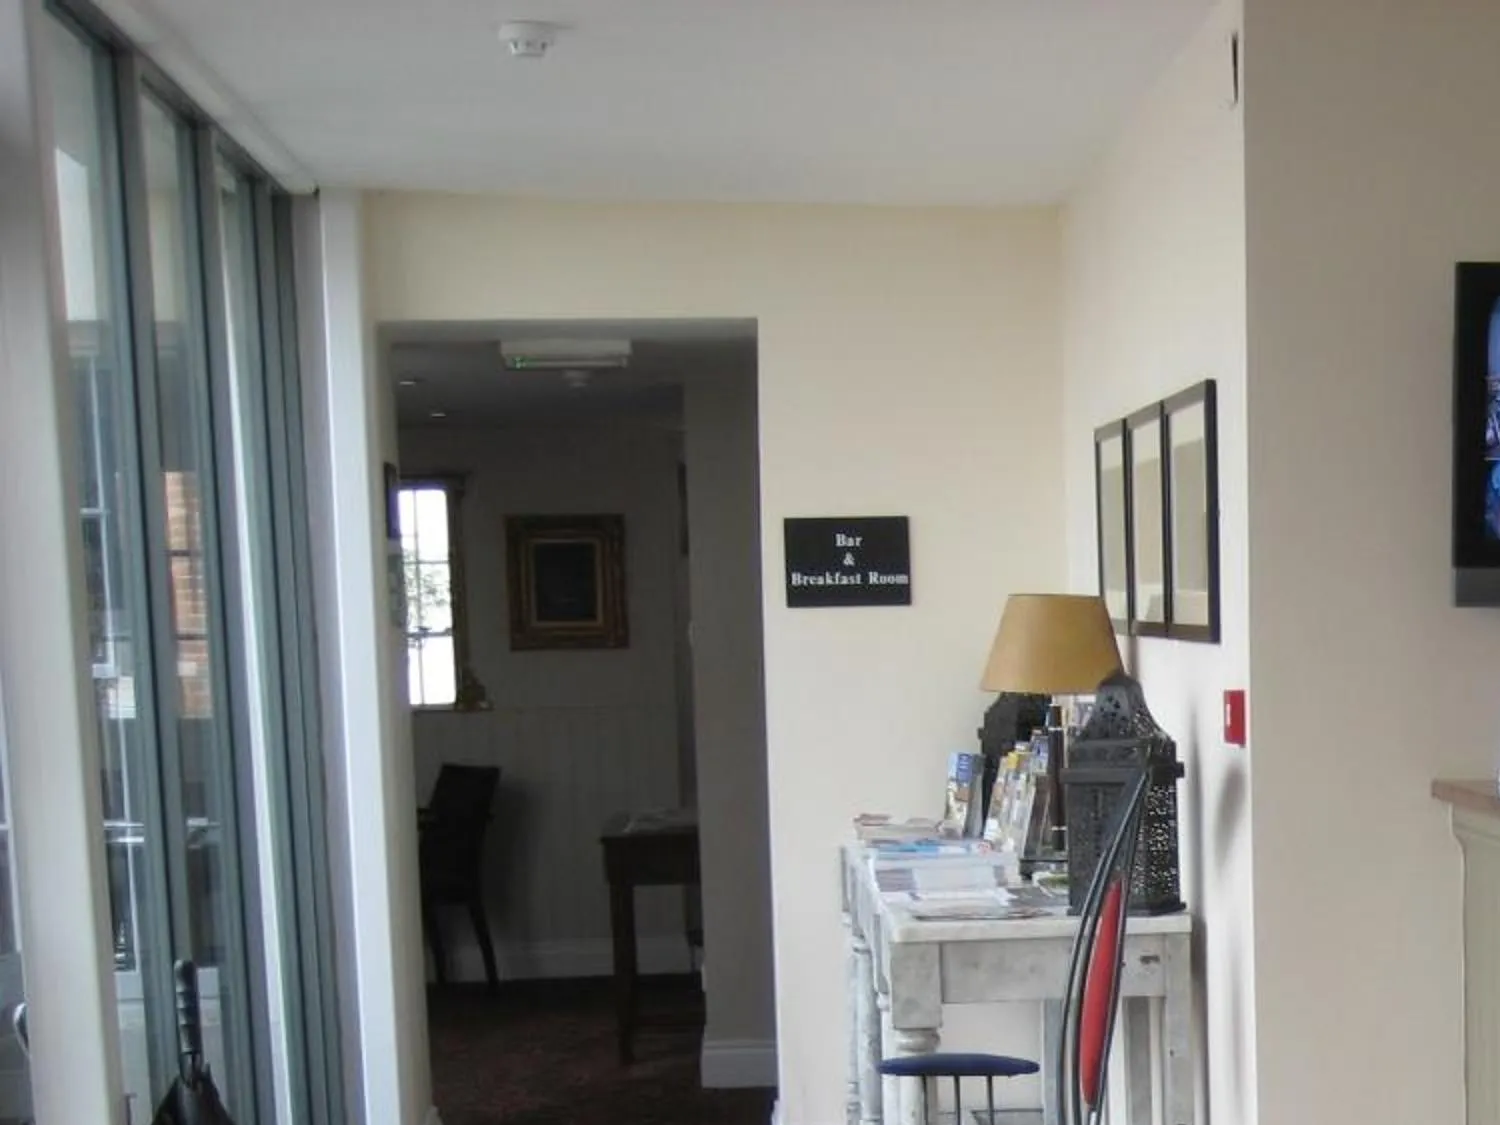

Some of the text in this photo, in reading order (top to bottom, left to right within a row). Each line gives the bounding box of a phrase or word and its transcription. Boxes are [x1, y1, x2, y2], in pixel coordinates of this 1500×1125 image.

[835, 533, 863, 547] Bar
[842, 552, 856, 566] &
[791, 571, 909, 586] Breakfast Room
